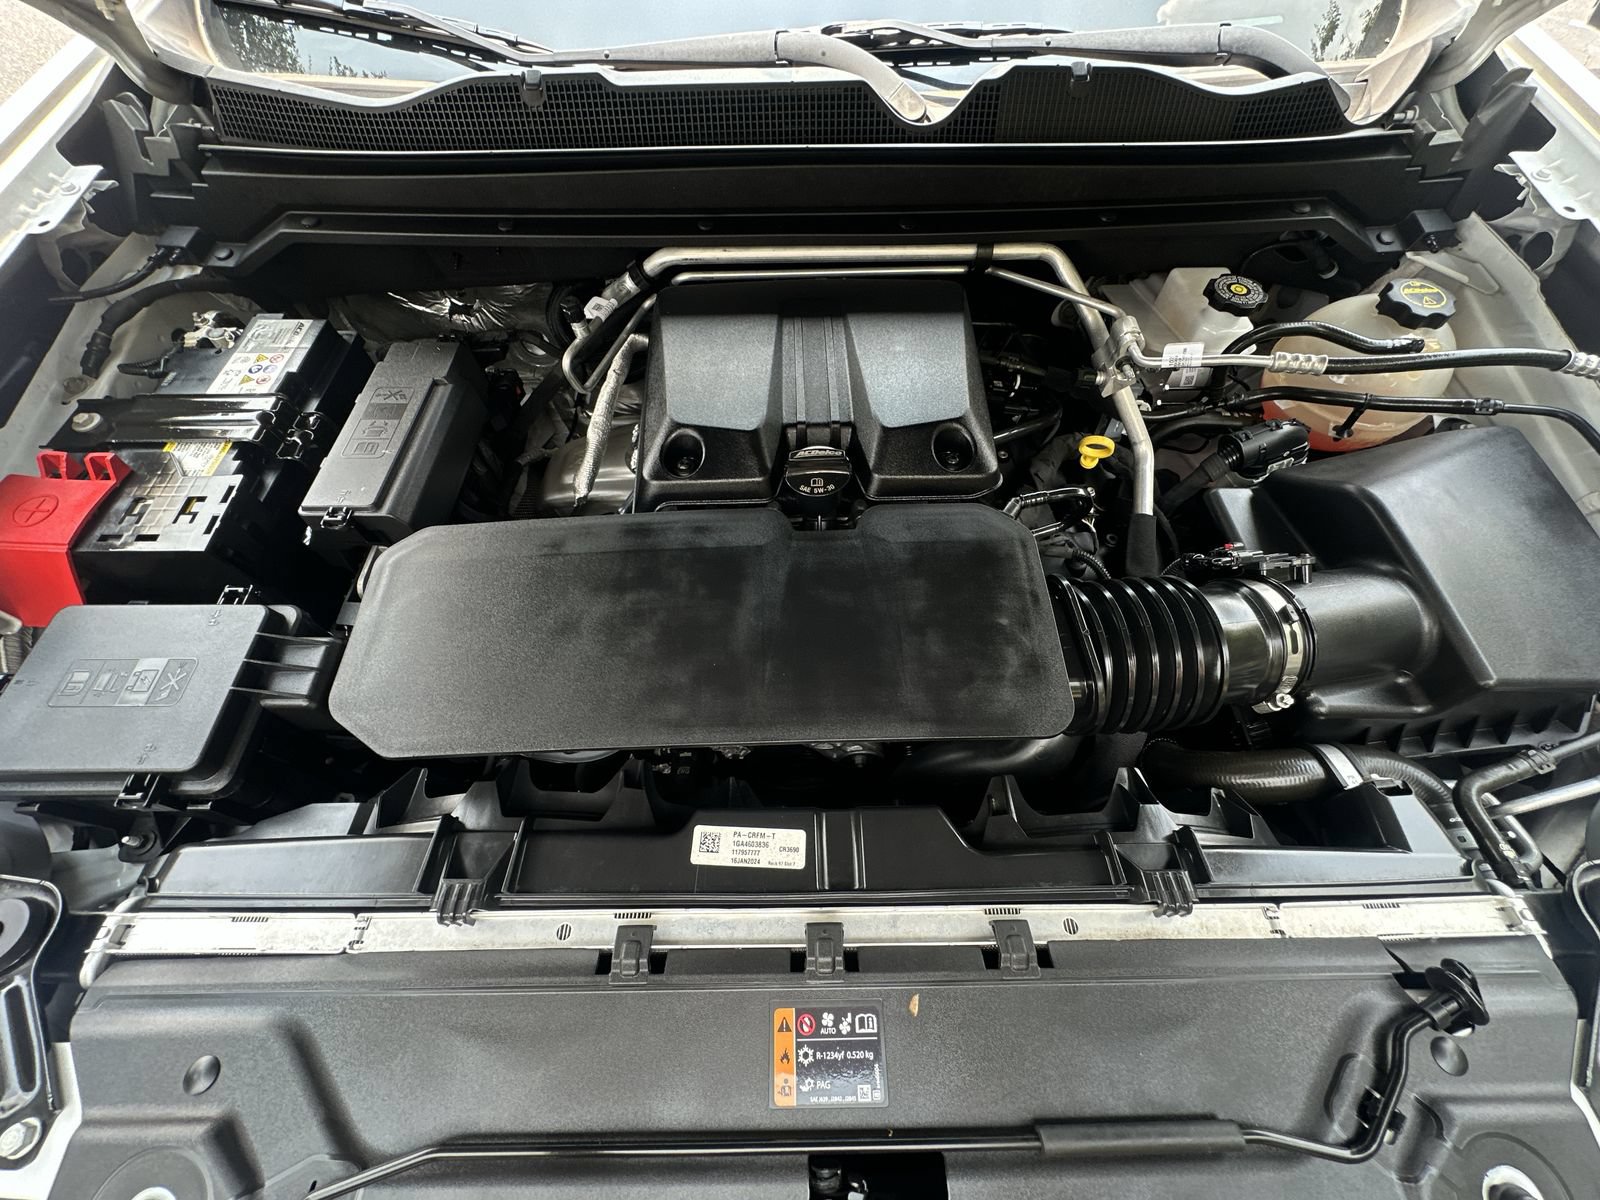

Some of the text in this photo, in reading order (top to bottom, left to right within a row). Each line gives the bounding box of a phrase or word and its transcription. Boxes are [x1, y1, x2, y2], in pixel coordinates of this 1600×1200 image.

[799, 484, 811, 493] SAE
[730, 857, 761, 865] 16JAN2024
[820, 1027, 837, 1035] AUTO
[815, 1050, 874, 1061] R-1234yf 0.520 kg
[816, 1080, 831, 1089] PAG
